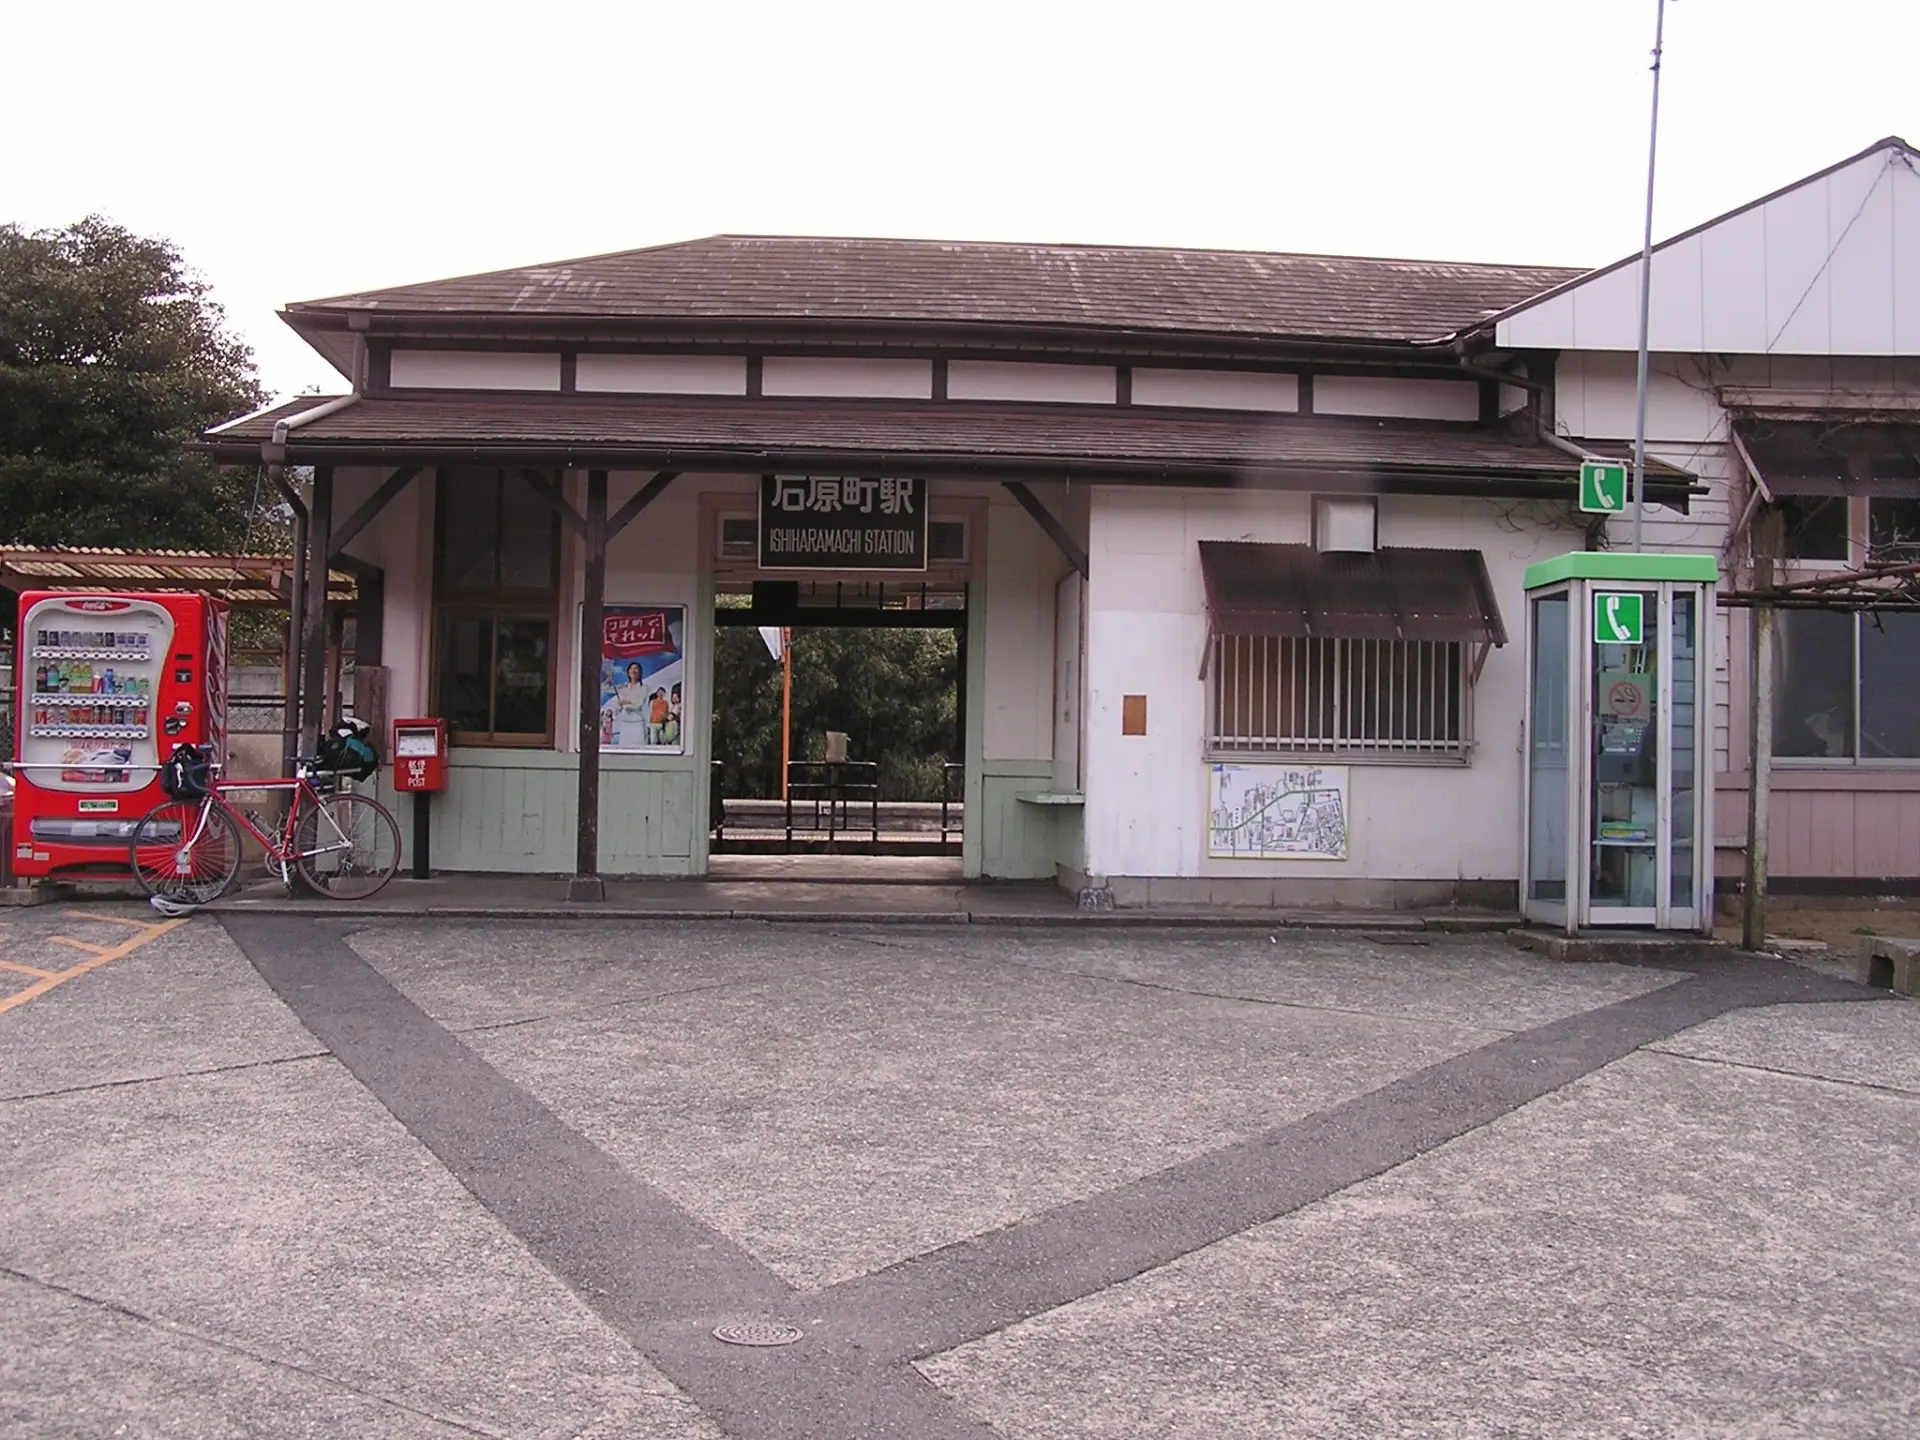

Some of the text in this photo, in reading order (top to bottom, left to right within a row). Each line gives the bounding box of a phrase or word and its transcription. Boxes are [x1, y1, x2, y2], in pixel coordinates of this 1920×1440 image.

[771, 475, 914, 514] 石原町駅
[770, 528, 914, 554] ISHIHARAMACHI STATION
[408, 777, 425, 787] POST
